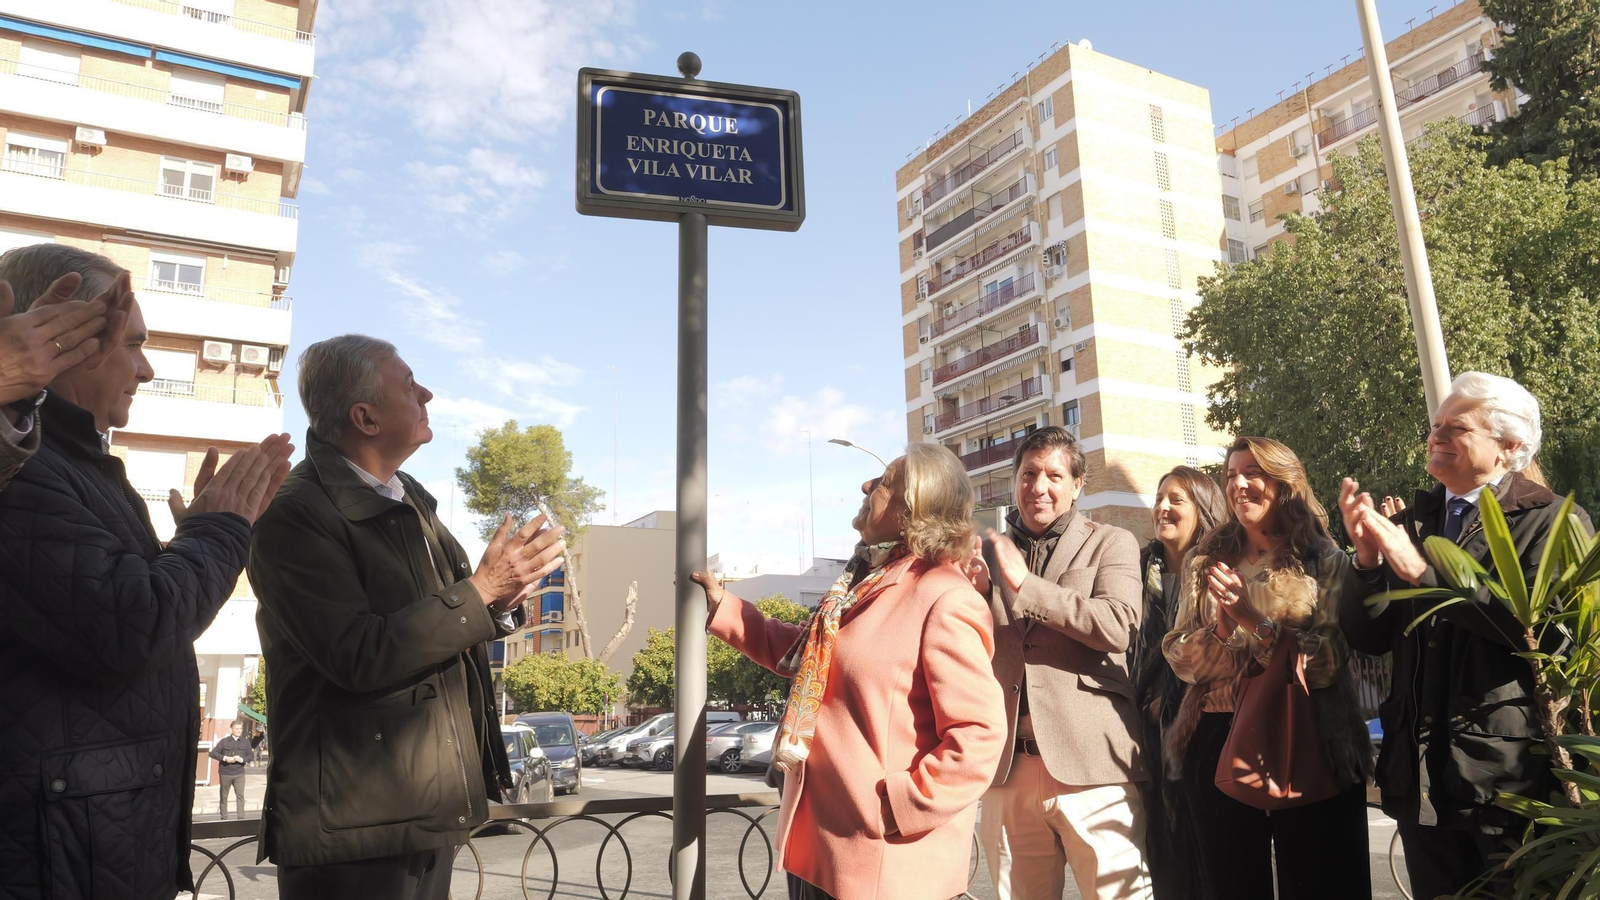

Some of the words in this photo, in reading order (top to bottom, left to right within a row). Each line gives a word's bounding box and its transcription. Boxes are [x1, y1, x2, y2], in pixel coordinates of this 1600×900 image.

[643, 108, 739, 135] PARQUE
[626, 134, 753, 162] ENRIQUETA
[626, 157, 681, 178] VILA
[685, 163, 753, 184] VILAR
